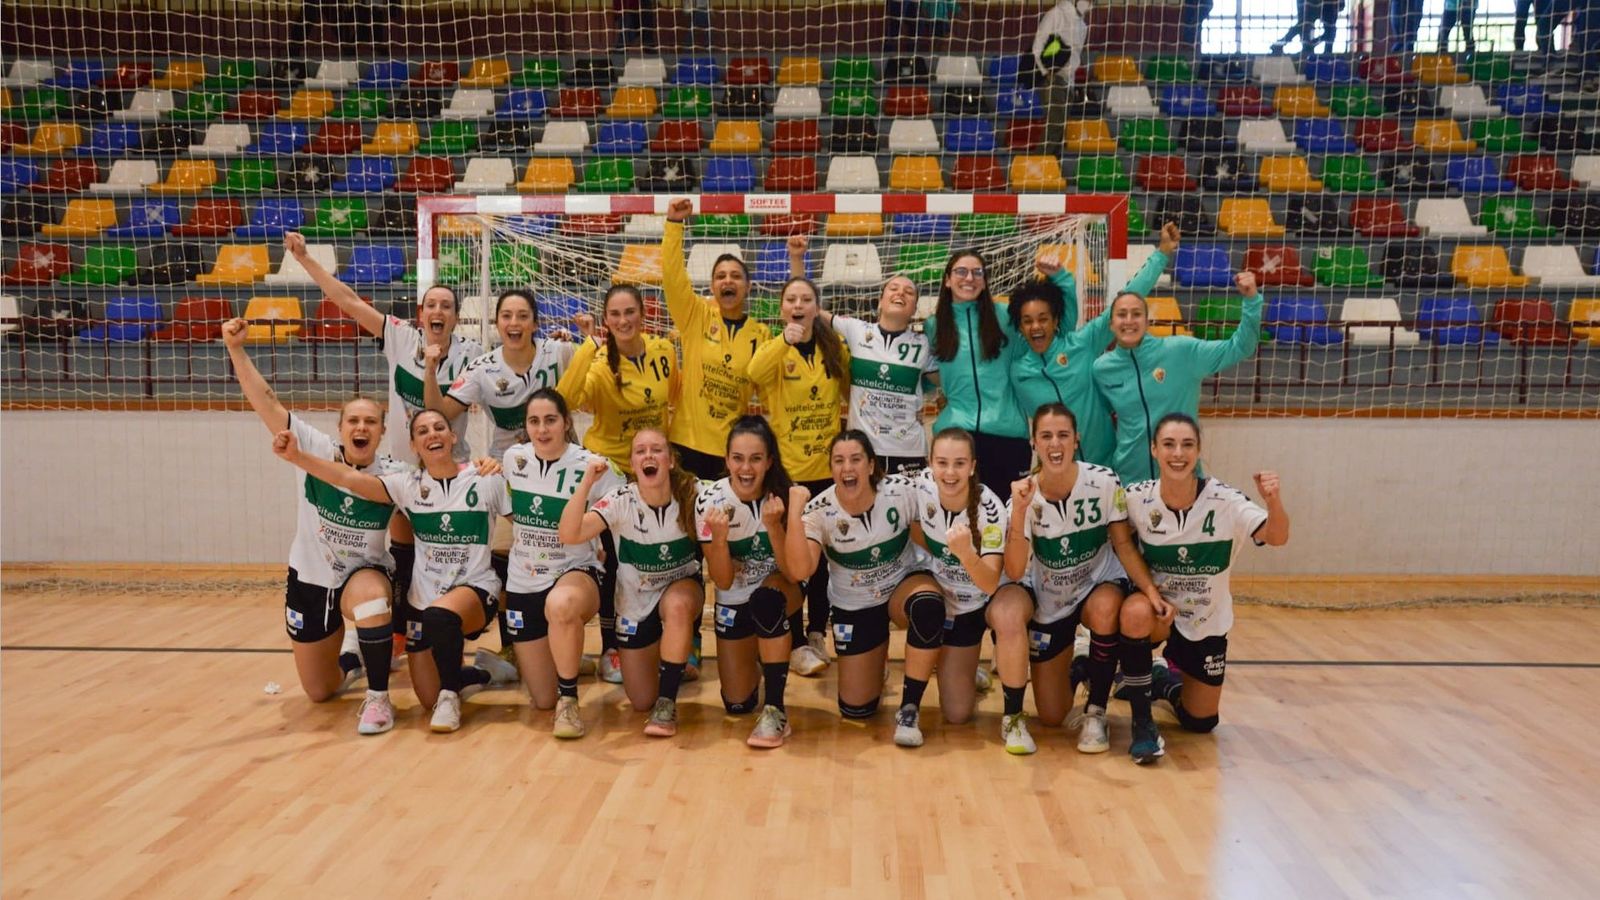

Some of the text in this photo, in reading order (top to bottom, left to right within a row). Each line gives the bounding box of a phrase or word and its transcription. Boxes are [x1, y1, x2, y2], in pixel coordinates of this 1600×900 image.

[751, 198, 786, 206] SOFTEE
[898, 342, 922, 363] 97
[650, 356, 670, 381] 18
[556, 468, 585, 495] 13
[466, 482, 478, 508] 6
[886, 506, 900, 533] 9
[1073, 497, 1102, 527] 33
[1202, 509, 1216, 537] 4
[520, 532, 560, 543] COMUNITAT
